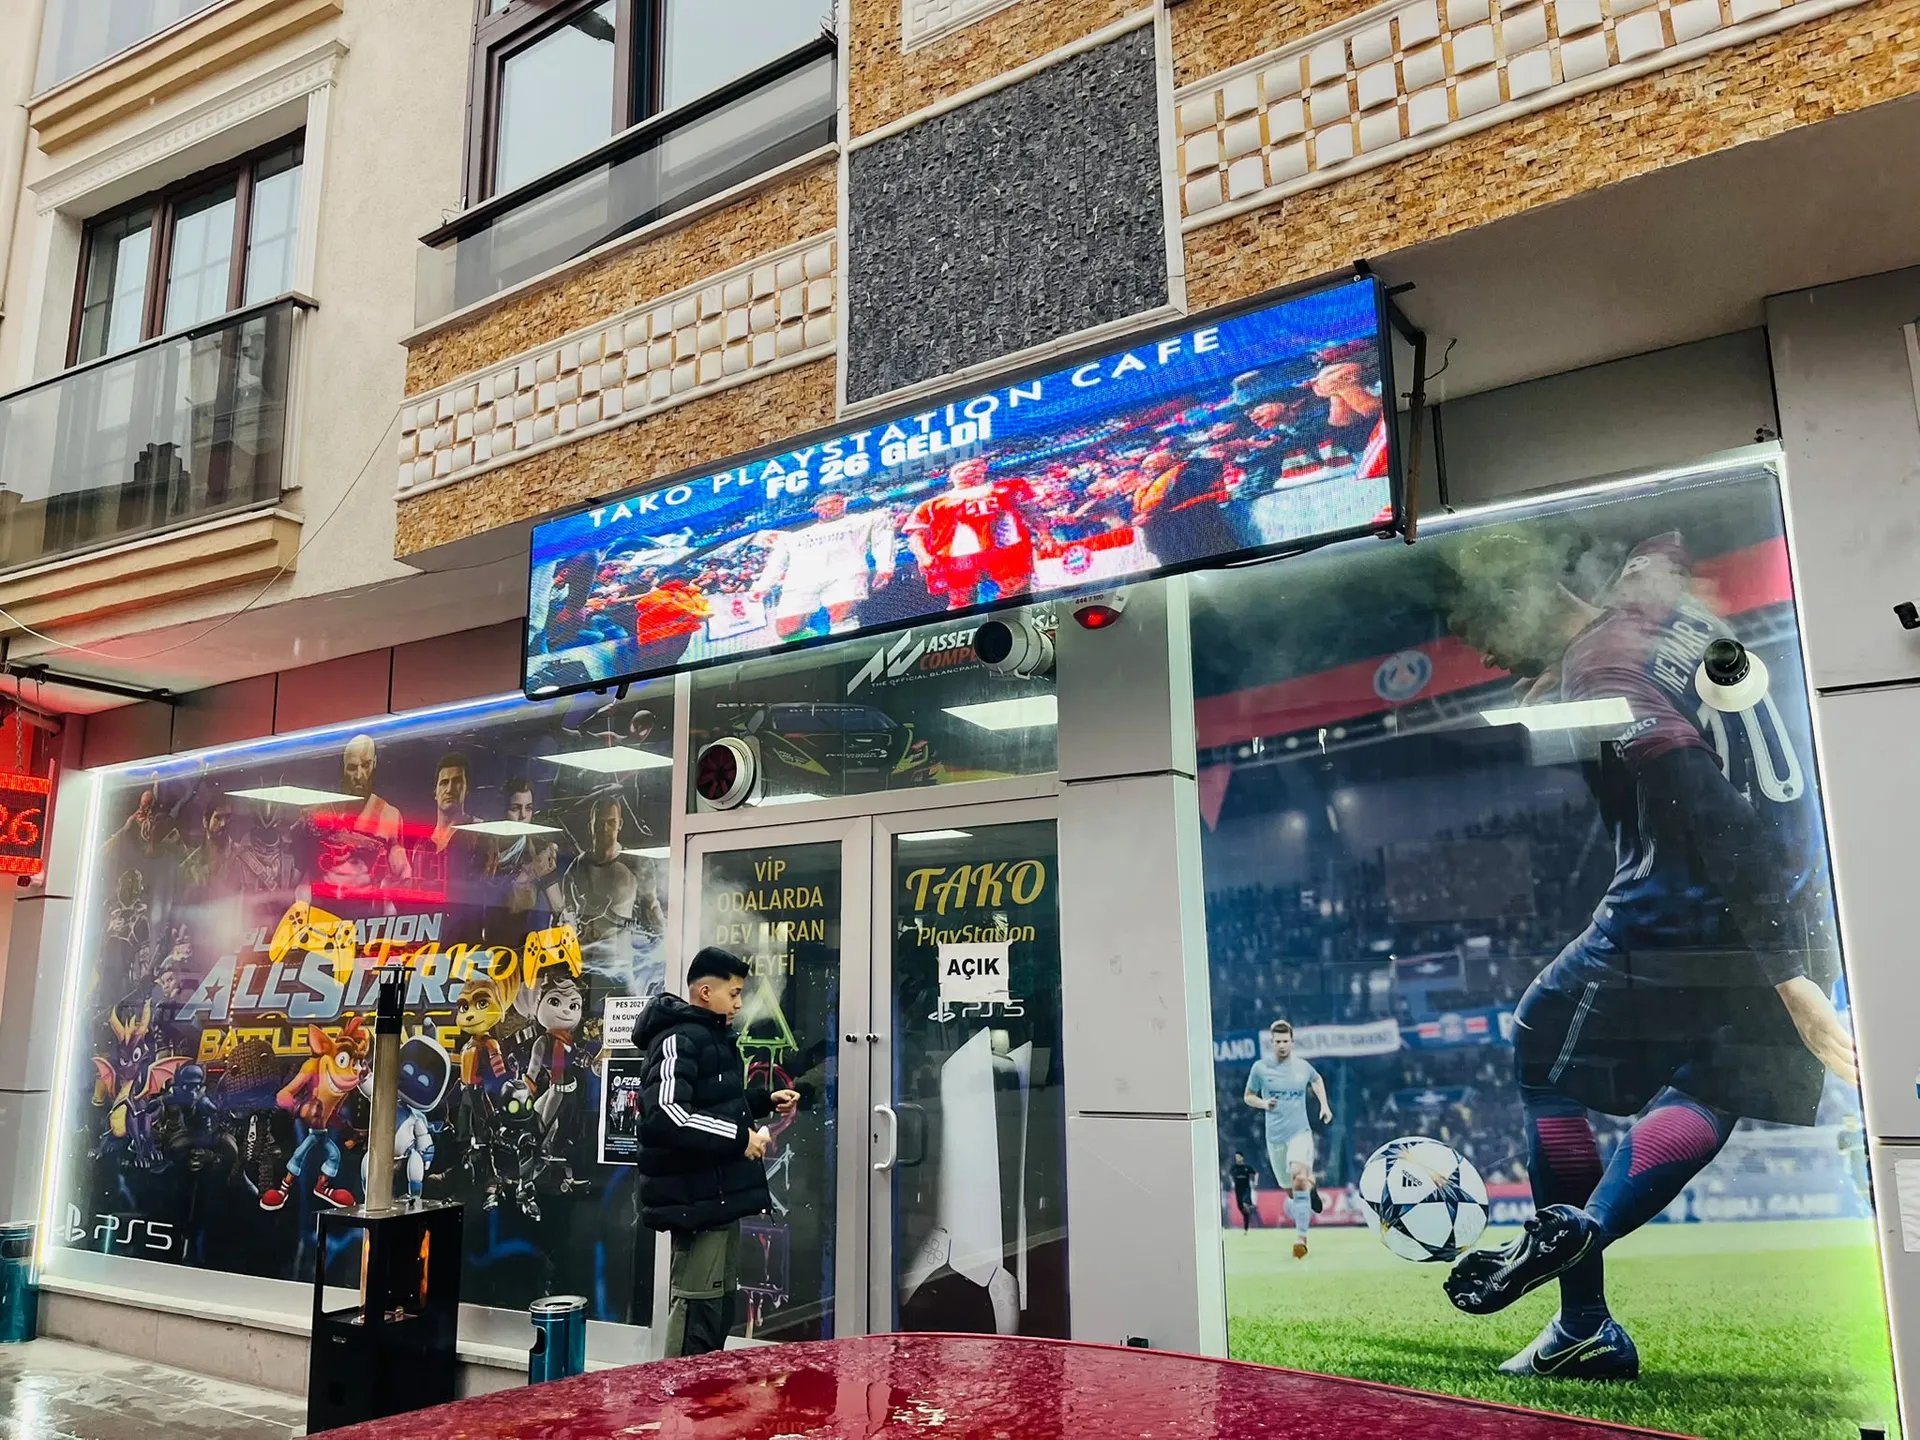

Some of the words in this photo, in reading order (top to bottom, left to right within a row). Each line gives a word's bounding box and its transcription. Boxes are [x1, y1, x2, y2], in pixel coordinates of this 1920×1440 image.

[588, 486, 692, 528] TAKO
[713, 382, 1041, 491] PLAYSTATION
[1072, 326, 1220, 388] CAFE
[766, 470, 809, 499] FC
[819, 452, 870, 483] 26
[926, 627, 978, 653] ASSET
[919, 644, 976, 671] COMP
[1653, 621, 1710, 694] NEYMAR
[890, 674, 928, 685] OFFICIAL
[930, 664, 981, 678] BLANCPAIN
[0, 804, 40, 845] 6
[718, 886, 824, 913] ODALARDA
[906, 860, 1045, 915] TAKO
[716, 922, 752, 945] DEV
[917, 924, 1036, 947] PlayStation
[364, 938, 518, 981] TAKO
[947, 958, 1000, 980] AÇIK
[94, 1213, 173, 1250] PS5
